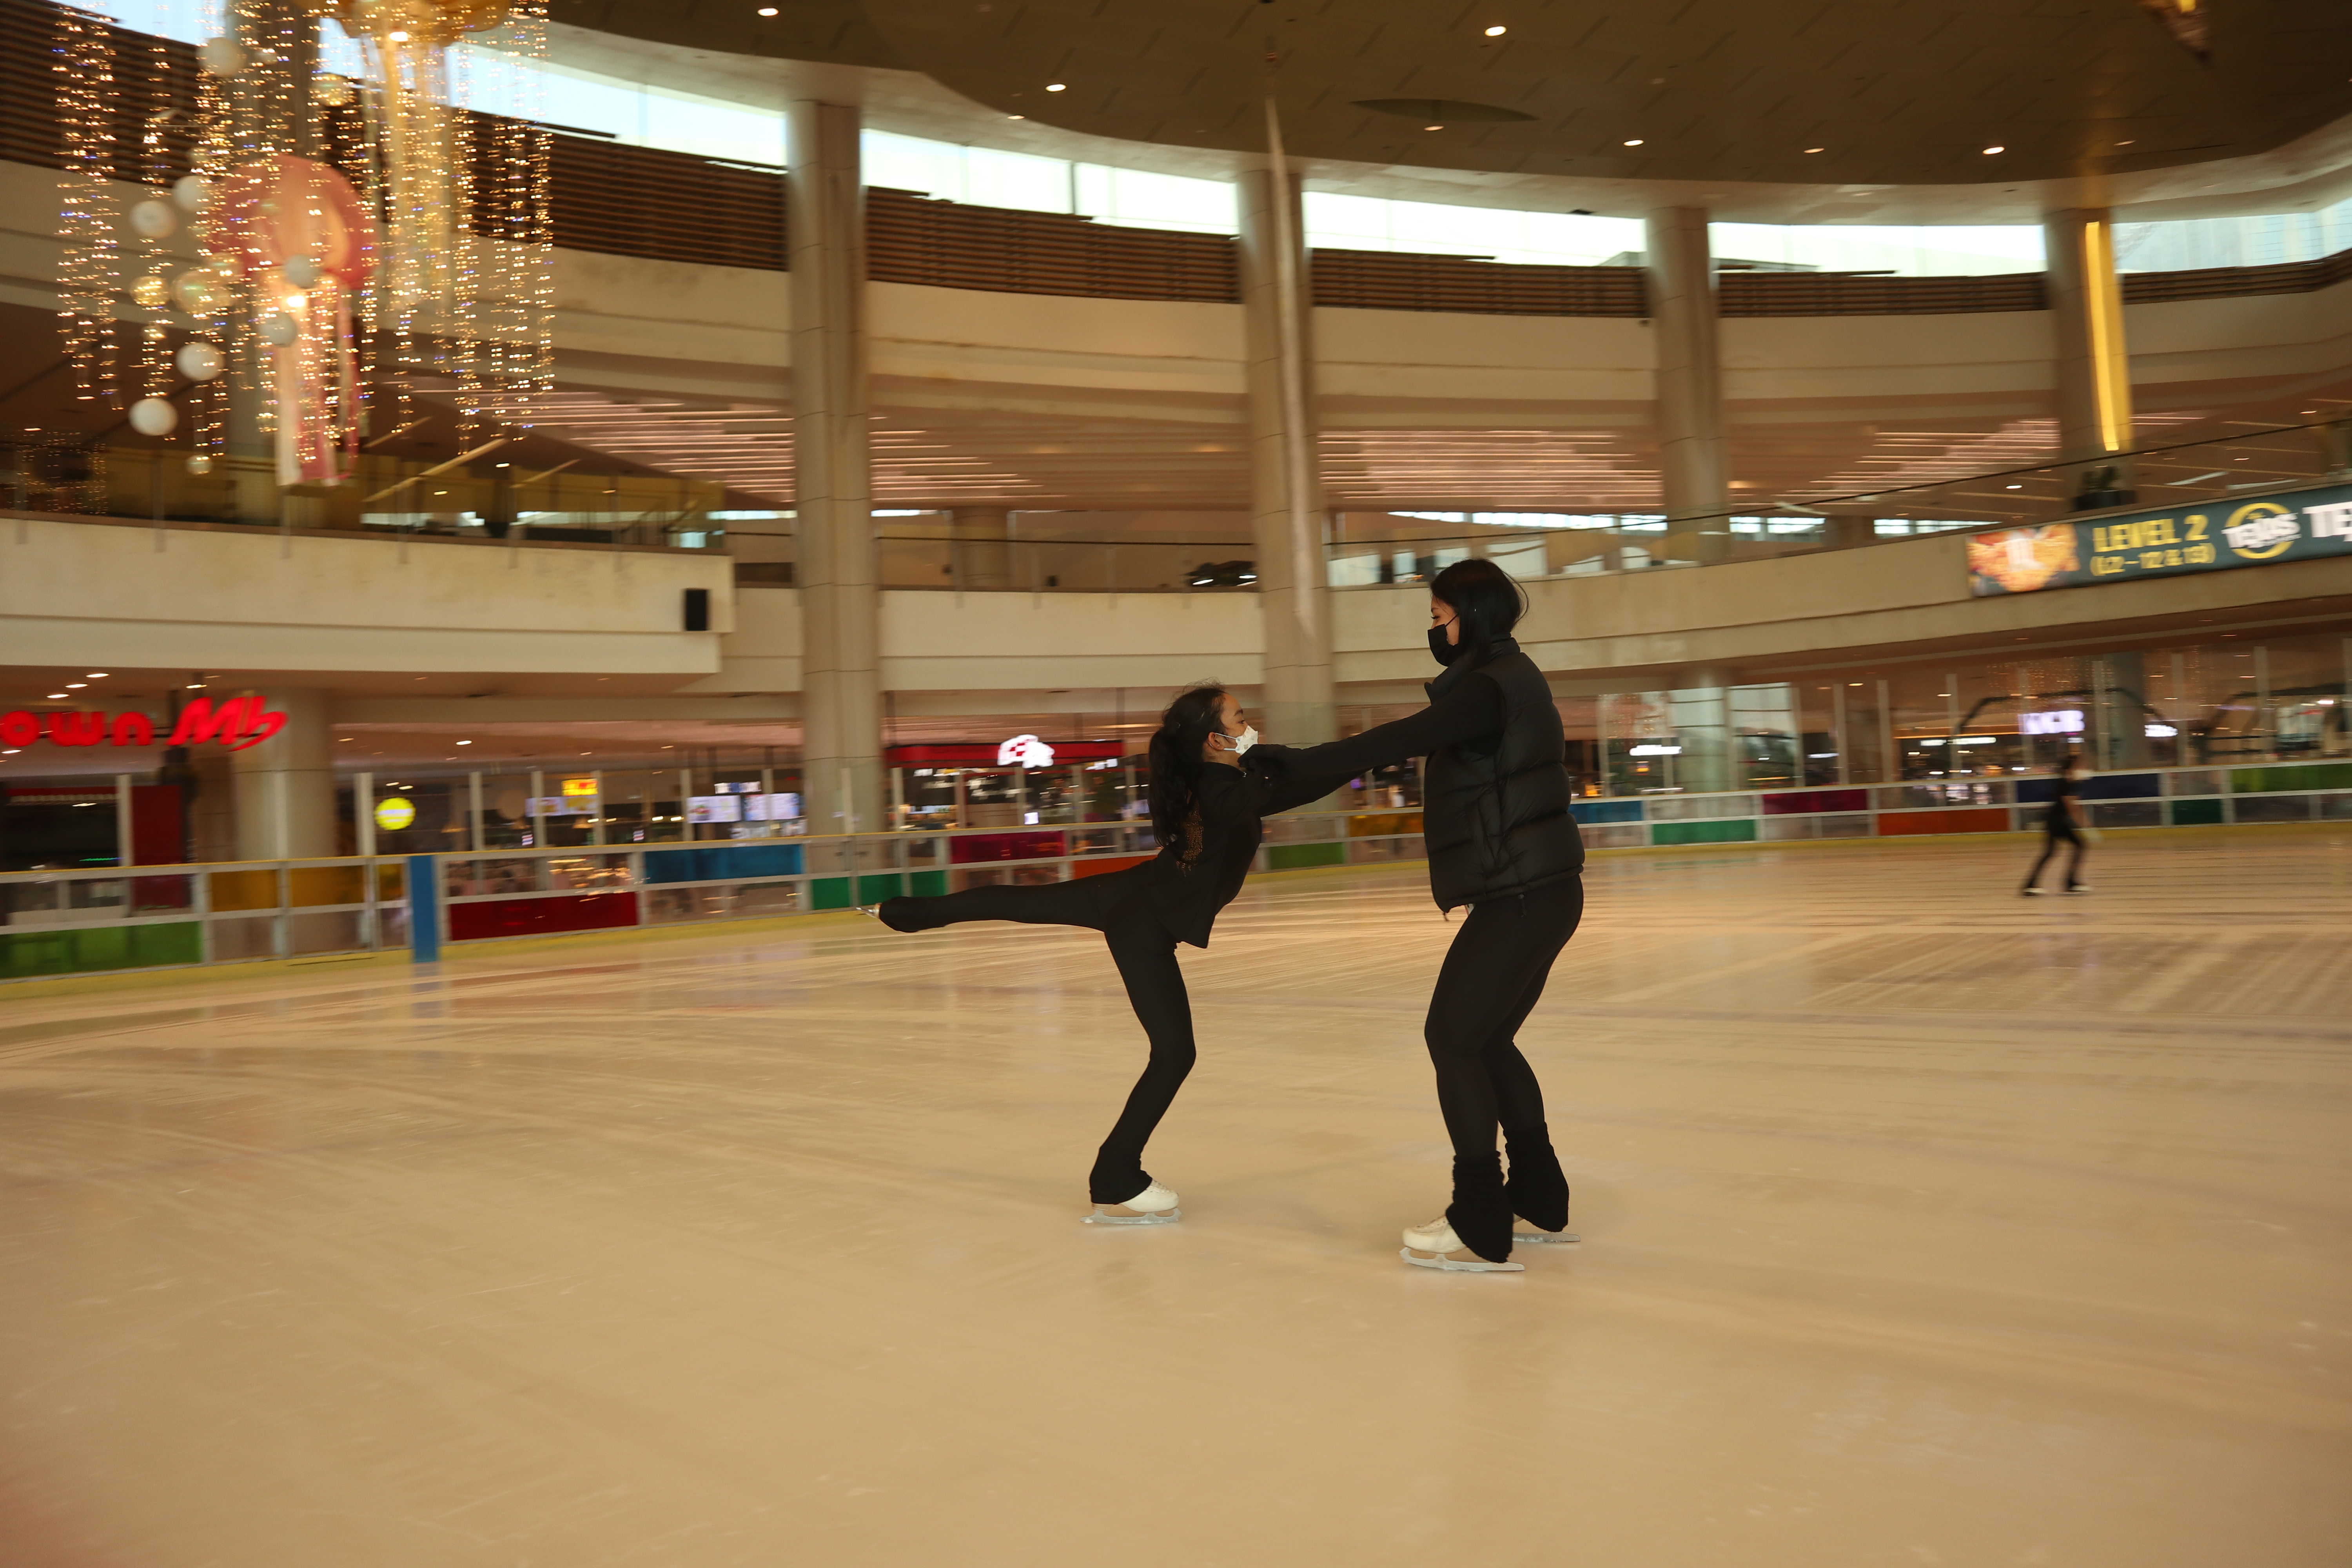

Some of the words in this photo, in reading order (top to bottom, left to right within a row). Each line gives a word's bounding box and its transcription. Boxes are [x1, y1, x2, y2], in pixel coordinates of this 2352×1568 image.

[2092, 518, 2182, 553] LEVEL
[2184, 514, 2210, 541] 2
[2302, 501, 2352, 542] TE
